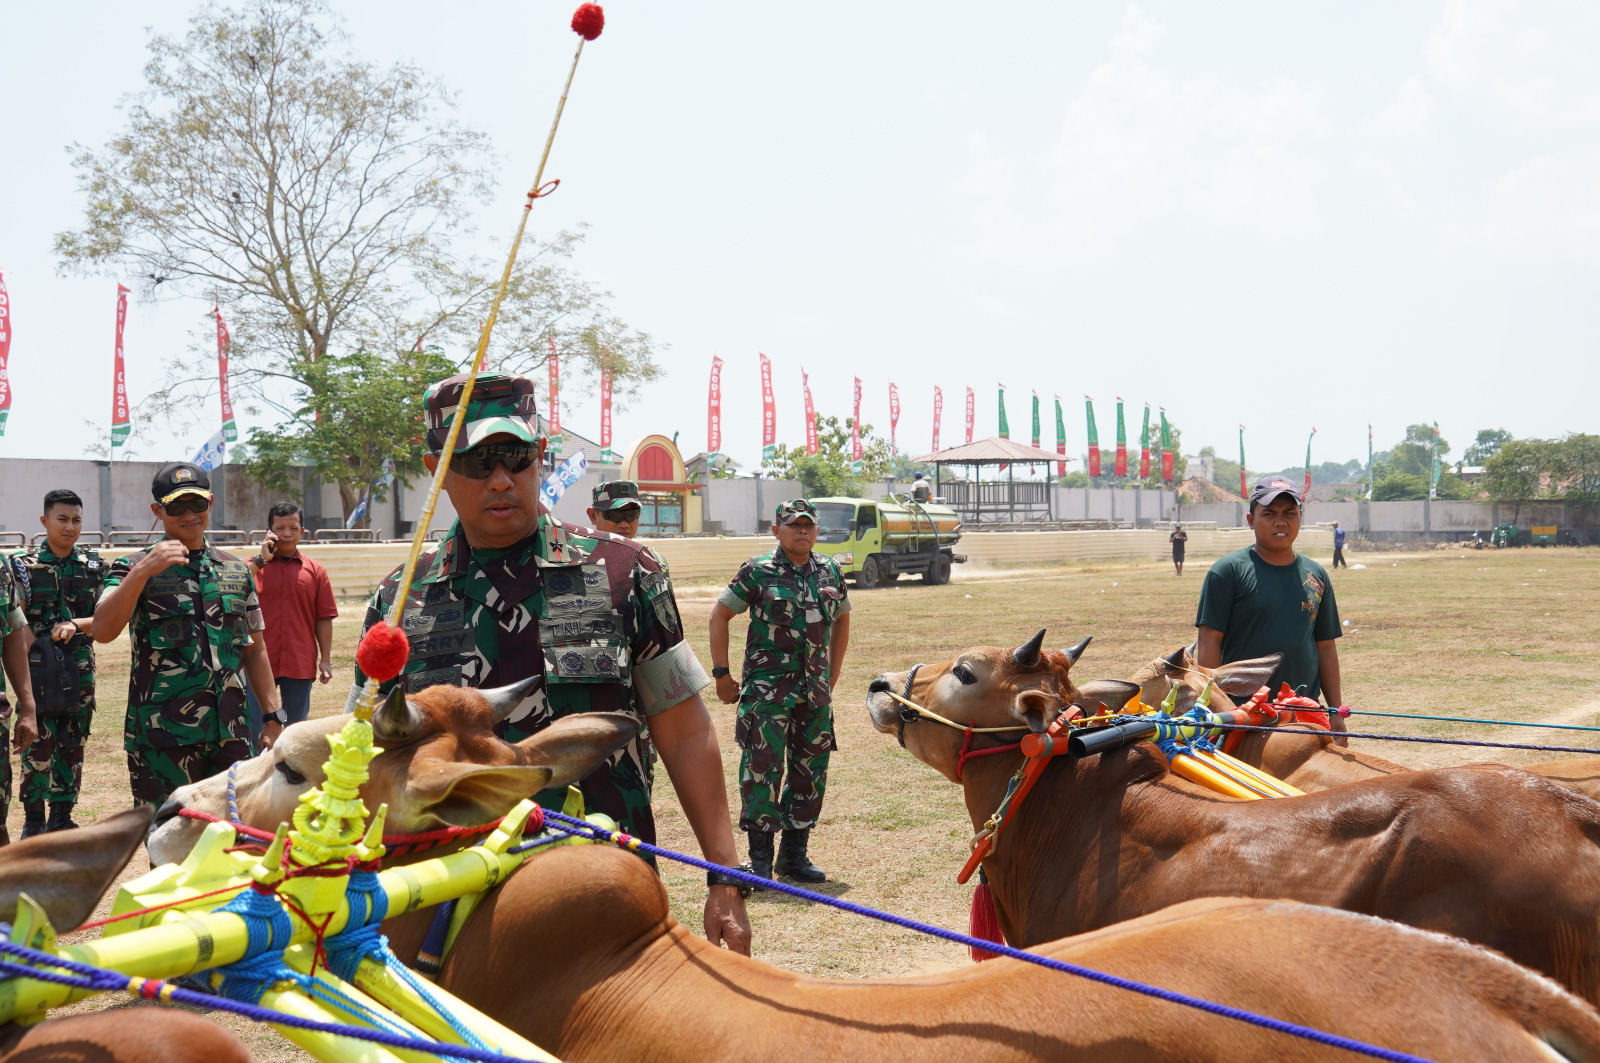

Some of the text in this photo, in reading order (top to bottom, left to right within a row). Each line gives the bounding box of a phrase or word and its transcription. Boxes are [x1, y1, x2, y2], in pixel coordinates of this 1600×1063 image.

[762, 364, 773, 403] KODIM
[711, 366, 719, 448] KODIM 0829
[890, 385, 898, 420] KODIM
[765, 410, 773, 442] 0829
[409, 633, 468, 655] ERRY
[548, 620, 617, 638] TNI AD
